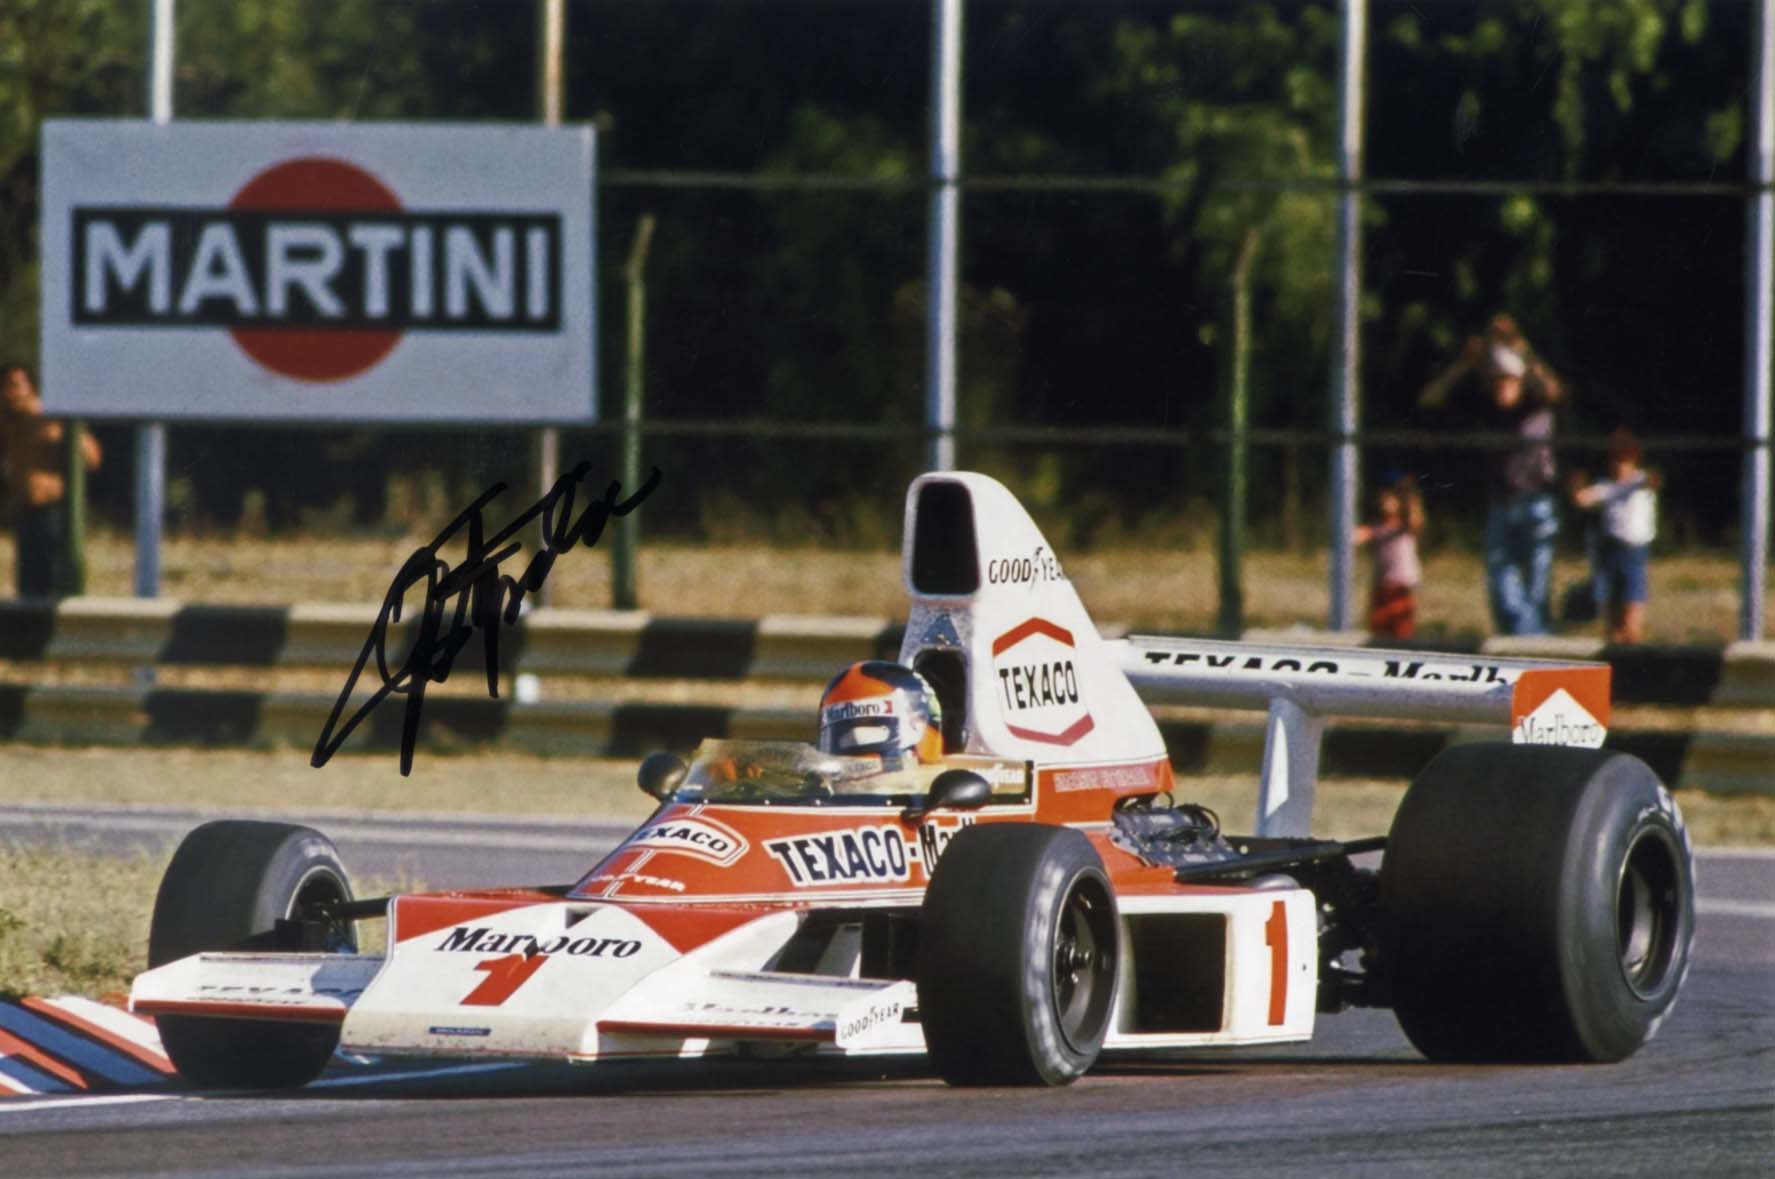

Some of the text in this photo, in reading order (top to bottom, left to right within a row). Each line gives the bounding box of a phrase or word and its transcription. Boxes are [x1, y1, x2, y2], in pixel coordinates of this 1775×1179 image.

[84, 221, 550, 319] MARTINI
[999, 660, 1078, 710] TEXACO
[459, 952, 550, 1006] 1
[1265, 900, 1288, 1024] 1
